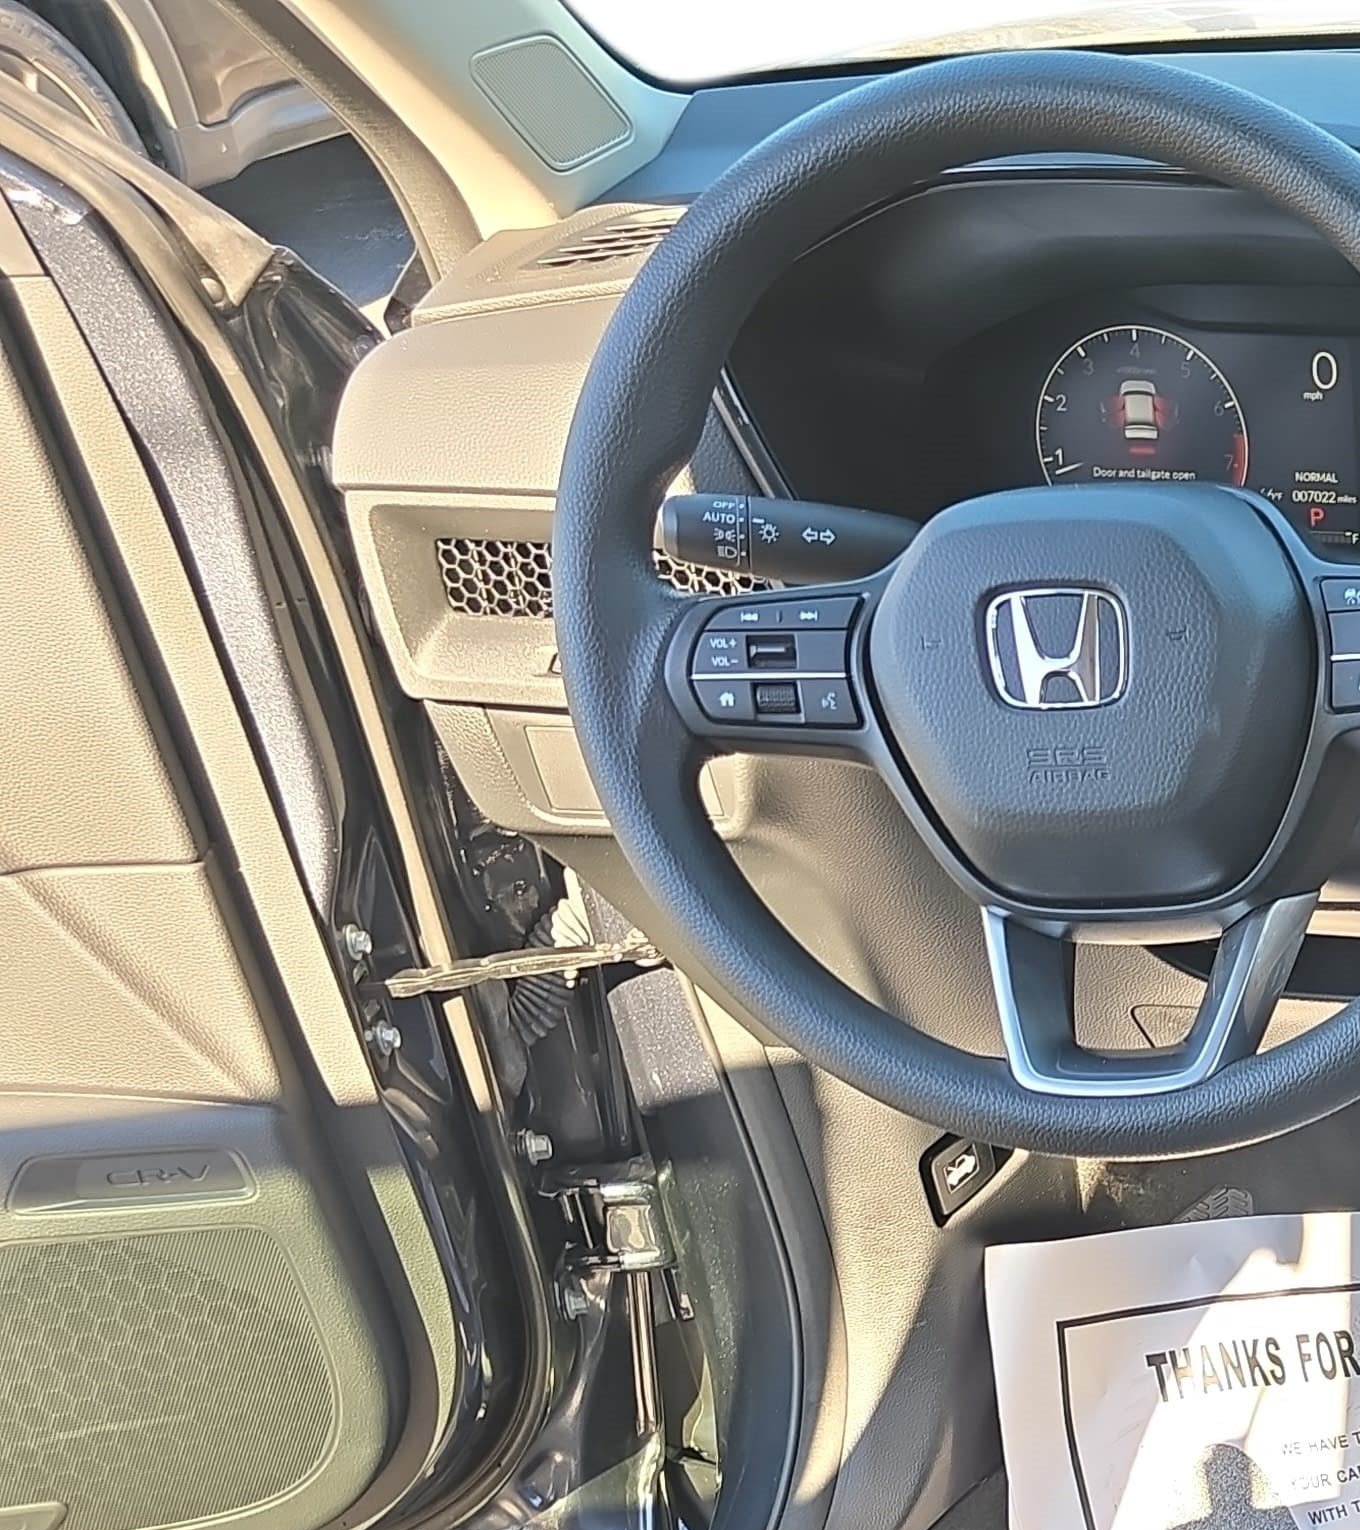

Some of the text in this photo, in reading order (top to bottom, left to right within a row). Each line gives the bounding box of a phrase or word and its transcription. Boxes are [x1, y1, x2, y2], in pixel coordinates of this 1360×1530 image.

[1129, 342, 1140, 358] 4
[1083, 359, 1094, 375] 3
[1311, 351, 1338, 390] 0
[1055, 395, 1067, 411] 2
[1303, 391, 1323, 401] mph
[1055, 449, 1064, 465] 1
[1093, 466, 1196, 481] Door and tailgate open
[1295, 472, 1338, 483] NORMAL
[713, 501, 735, 509] OFF
[1292, 490, 1336, 504] 007022
[702, 512, 736, 524] AUTO
[1310, 507, 1324, 527] P
[1146, 1336, 1287, 1402] THANKS
[1308, 1435, 1350, 1454] HAVE
[1307, 1504, 1348, 1526] WITH
